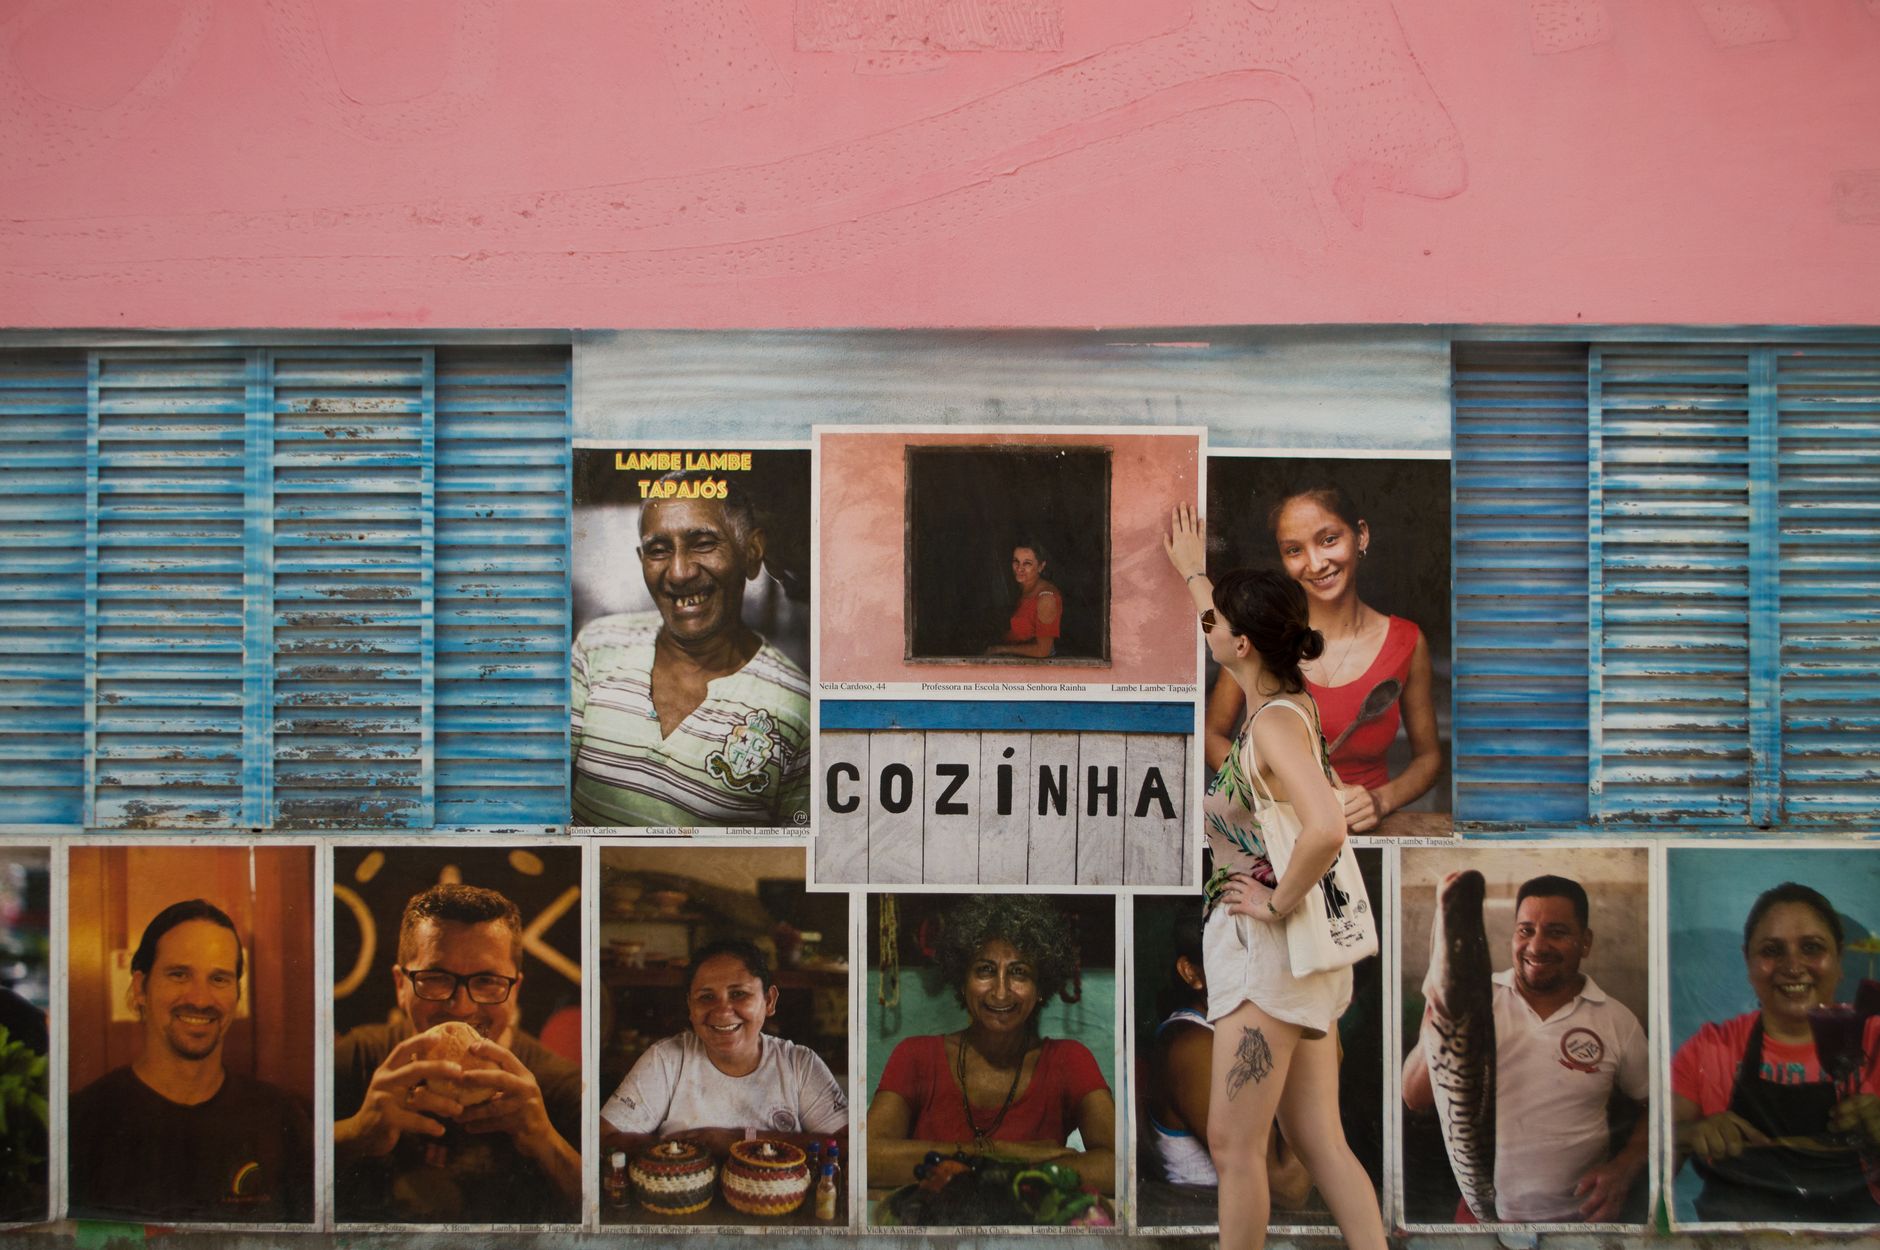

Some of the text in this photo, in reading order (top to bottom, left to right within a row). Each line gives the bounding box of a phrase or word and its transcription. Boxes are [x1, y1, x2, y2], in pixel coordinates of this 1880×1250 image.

[615, 451, 752, 471] LAMBE LAMBE
[638, 476, 729, 499] TAPAJÓS
[819, 682, 839, 691] Neila
[840, 682, 875, 692] Cardoso,
[876, 683, 886, 691] 44
[921, 682, 962, 691] Professora
[974, 683, 1000, 691] Escola
[1002, 683, 1025, 691] Nossa
[1026, 683, 1058, 692] Senhora
[1059, 683, 1087, 692] Rainha
[1111, 684, 1138, 692] Lambe
[1139, 684, 1166, 692] Lambe
[1168, 684, 1197, 694] Tapajós
[592, 827, 617, 835] Carlos
[645, 827, 665, 835] Casa
[666, 827, 676, 835] do
[678, 827, 700, 835] Saulo
[725, 827, 752, 835] Lambe
[753, 827, 780, 835] Lambe
[782, 827, 811, 837] Tapajós
[1369, 837, 1396, 845] Lambe
[1397, 837, 1423, 845] Lambe
[1031, 1225, 1057, 1235] Lambe
[1059, 1226, 1085, 1235] Lambe
